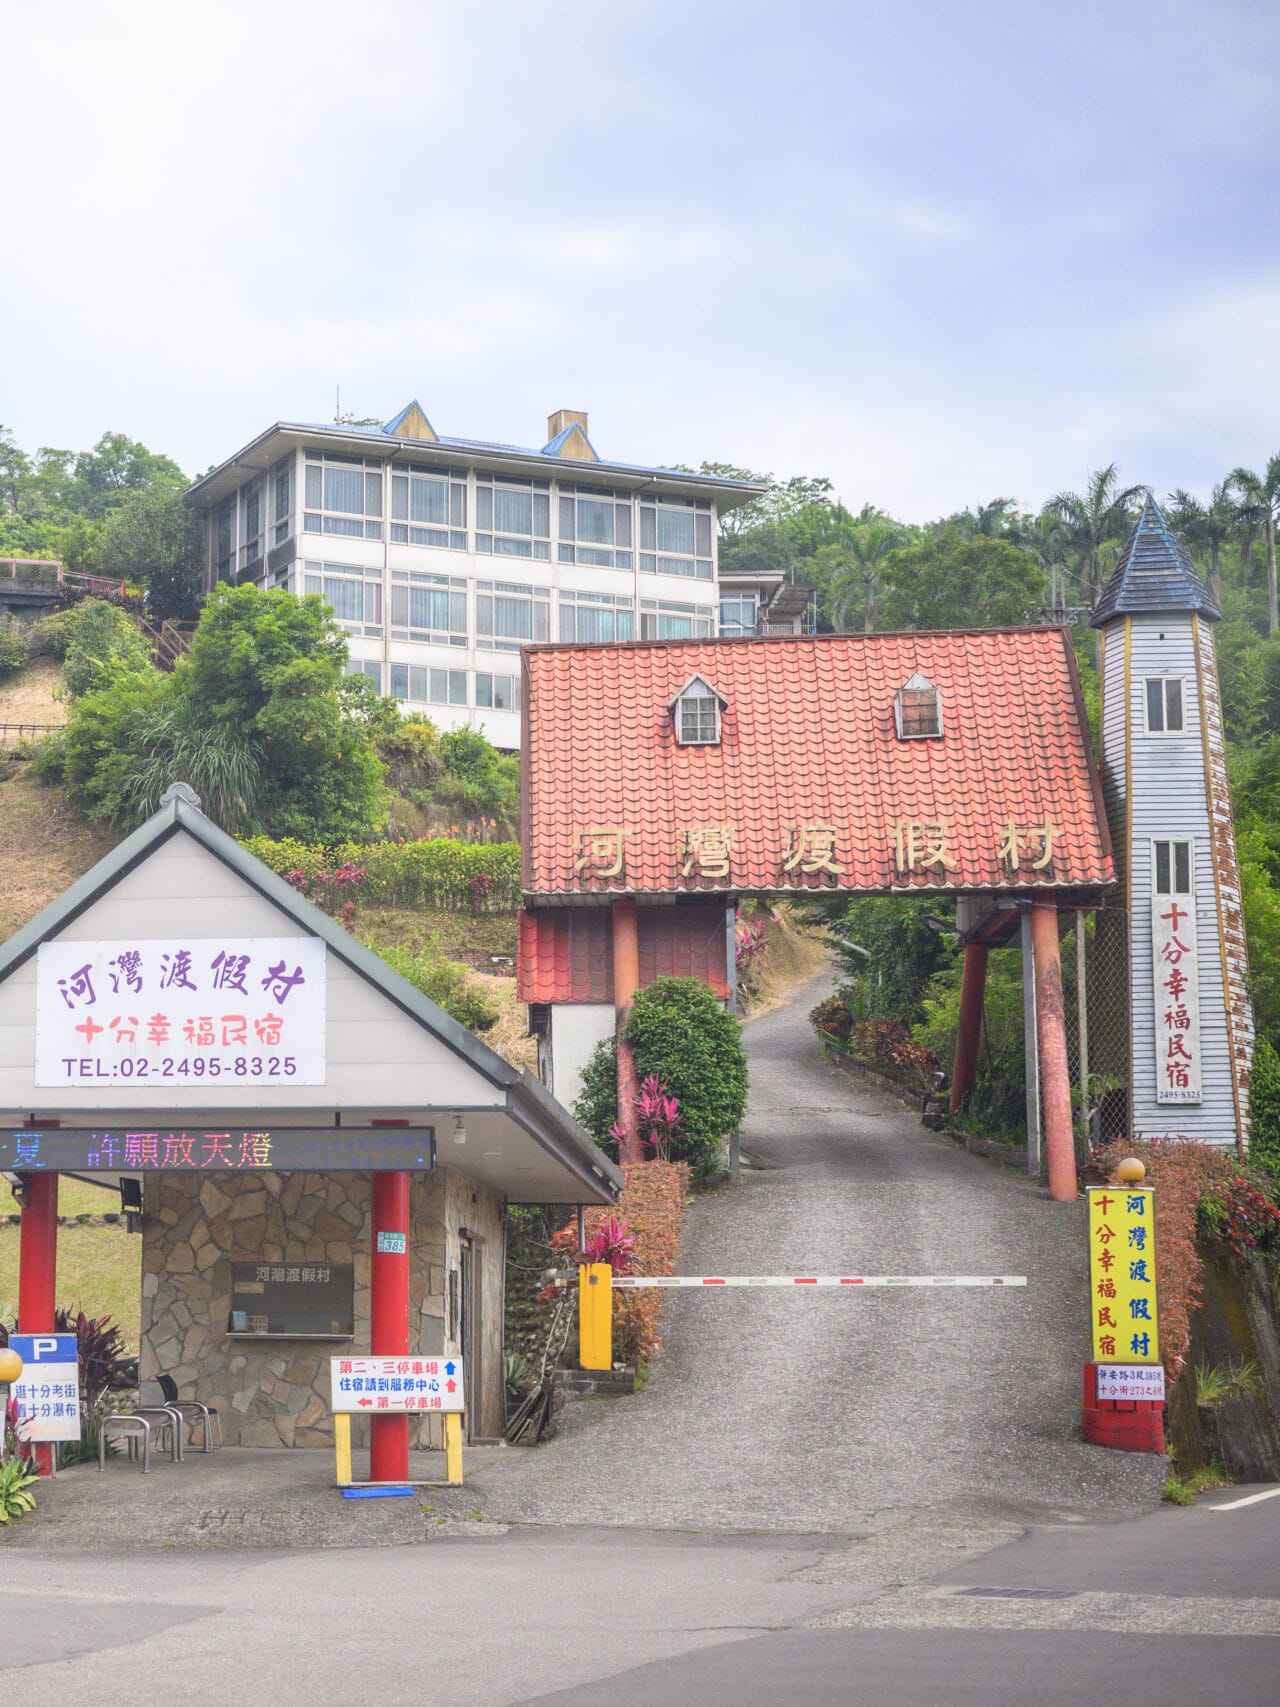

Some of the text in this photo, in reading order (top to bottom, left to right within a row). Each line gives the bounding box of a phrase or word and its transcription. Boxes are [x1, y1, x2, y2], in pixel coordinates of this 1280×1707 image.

[572, 817, 1066, 878] 河灣渡假村
[56, 949, 306, 1010] 河灣渡假村
[1160, 902, 1192, 1089] 十分幸福民宿
[74, 1012, 285, 1047] 十分幸福民宿
[384, 1240, 405, 1252] 385
[255, 1266, 331, 1283] 河灣渡假村
[1094, 1194, 1117, 1357] 十分幸福民宿
[1126, 1194, 1152, 1357] 河灣渡假村
[33, 1338, 58, 1360] P
[339, 1360, 439, 1375] 第二、三停車場
[15, 1384, 76, 1399] 逛十分老街
[339, 1377, 440, 1392] 住宿請到服務中心
[377, 1396, 442, 1409] 第一停車場
